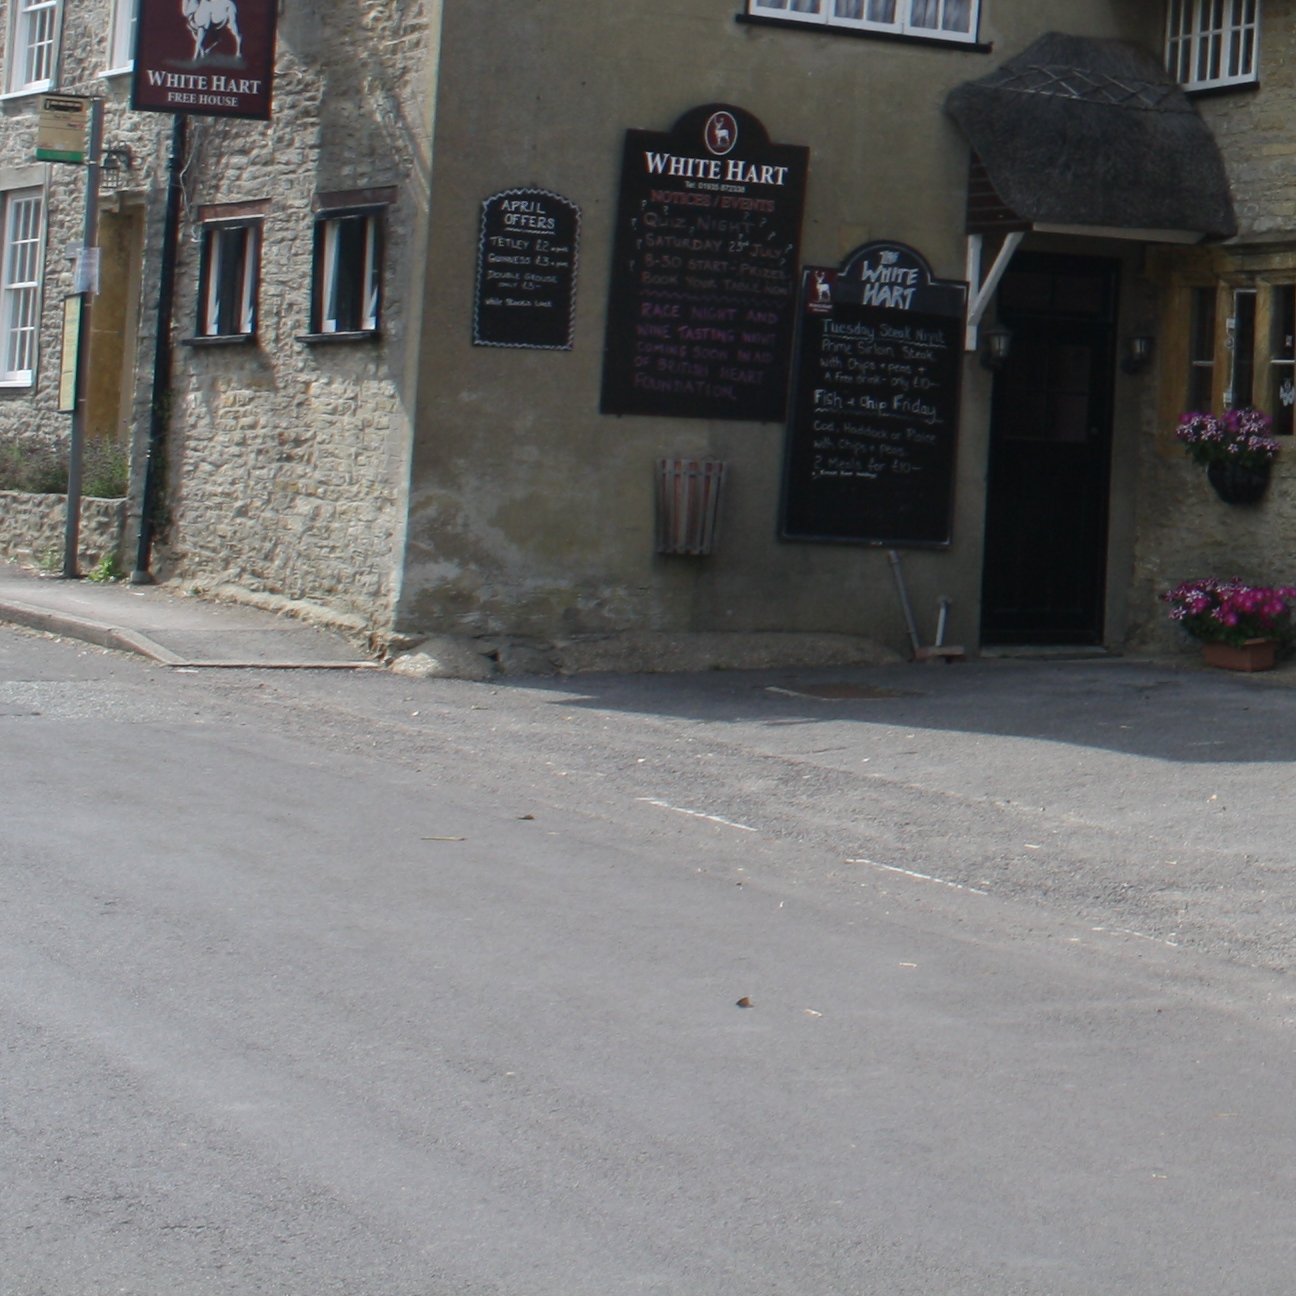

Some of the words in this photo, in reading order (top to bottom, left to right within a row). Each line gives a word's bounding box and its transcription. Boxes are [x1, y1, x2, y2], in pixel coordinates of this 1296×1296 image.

[146, 69, 208, 90] WHITE
[211, 74, 262, 95] HART
[167, 91, 197, 105] FREE
[199, 92, 239, 107] HOUSE
[644, 151, 722, 180] WHITE
[725, 159, 789, 186] HART
[501, 199, 547, 214] APRIL
[650, 189, 712, 207] NOTICES
[720, 196, 776, 213] EVENTS
[504, 214, 555, 229] OFFERS
[643, 212, 687, 229] QUIZ
[696, 215, 755, 234] NIGHT
[489, 235, 530, 250] TETLEY
[645, 233, 723, 253] SATURDAY
[750, 243, 783, 259] JULY
[687, 259, 729, 273] START
[861, 260, 920, 285] WHITE
[640, 271, 679, 286] BOOK
[862, 282, 917, 310] HART
[640, 302, 680, 318] RACE
[690, 306, 738, 321] NIGHT
[744, 309, 778, 325] AND
[635, 324, 672, 339] WINE
[677, 325, 736, 343] TASTING
[821, 318, 875, 343] Tuesday
[880, 323, 912, 340] Steak
[813, 388, 843, 409] Fish
[860, 395, 888, 417] Chip
[892, 393, 937, 425] Friday
